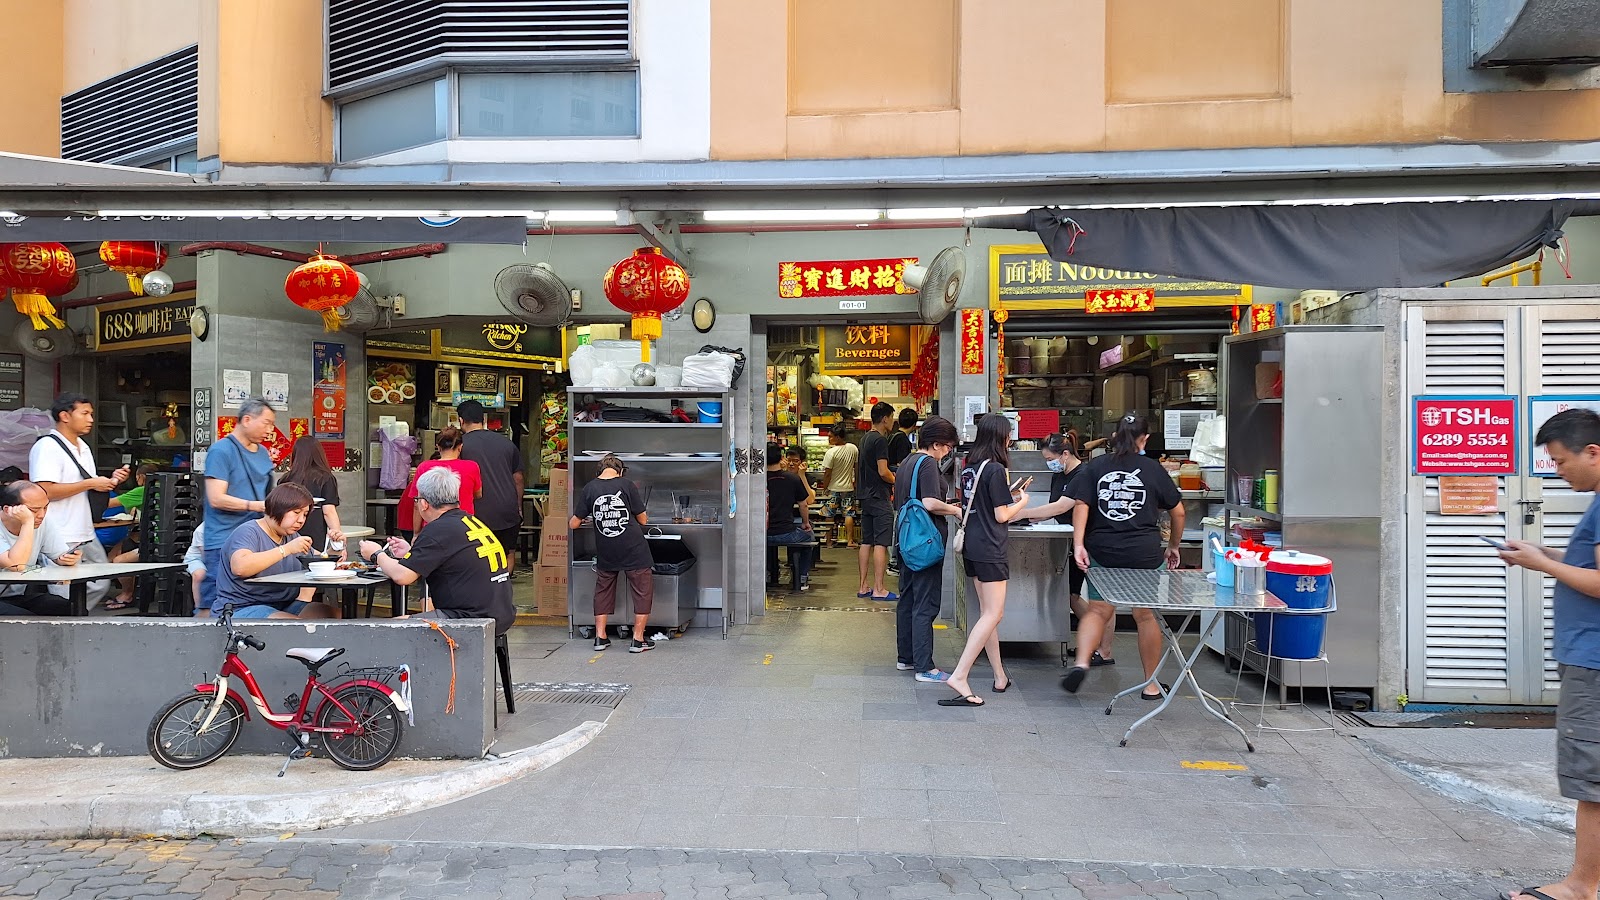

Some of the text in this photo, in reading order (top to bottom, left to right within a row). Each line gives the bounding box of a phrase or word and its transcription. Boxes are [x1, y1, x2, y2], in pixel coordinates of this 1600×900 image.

[1004, 259, 1052, 284] 面摊
[105, 306, 196, 340] 688 咖啡店 EAT
[845, 325, 890, 345] 饮料
[966, 314, 980, 363] 大吉大利
[835, 347, 900, 359] Beverages
[1441, 408, 1510, 425] TSH Gas
[1422, 433, 1508, 446] 6289 5554
[1536, 460, 1544, 469] NO
[1108, 500, 1128, 509] HOUSE
